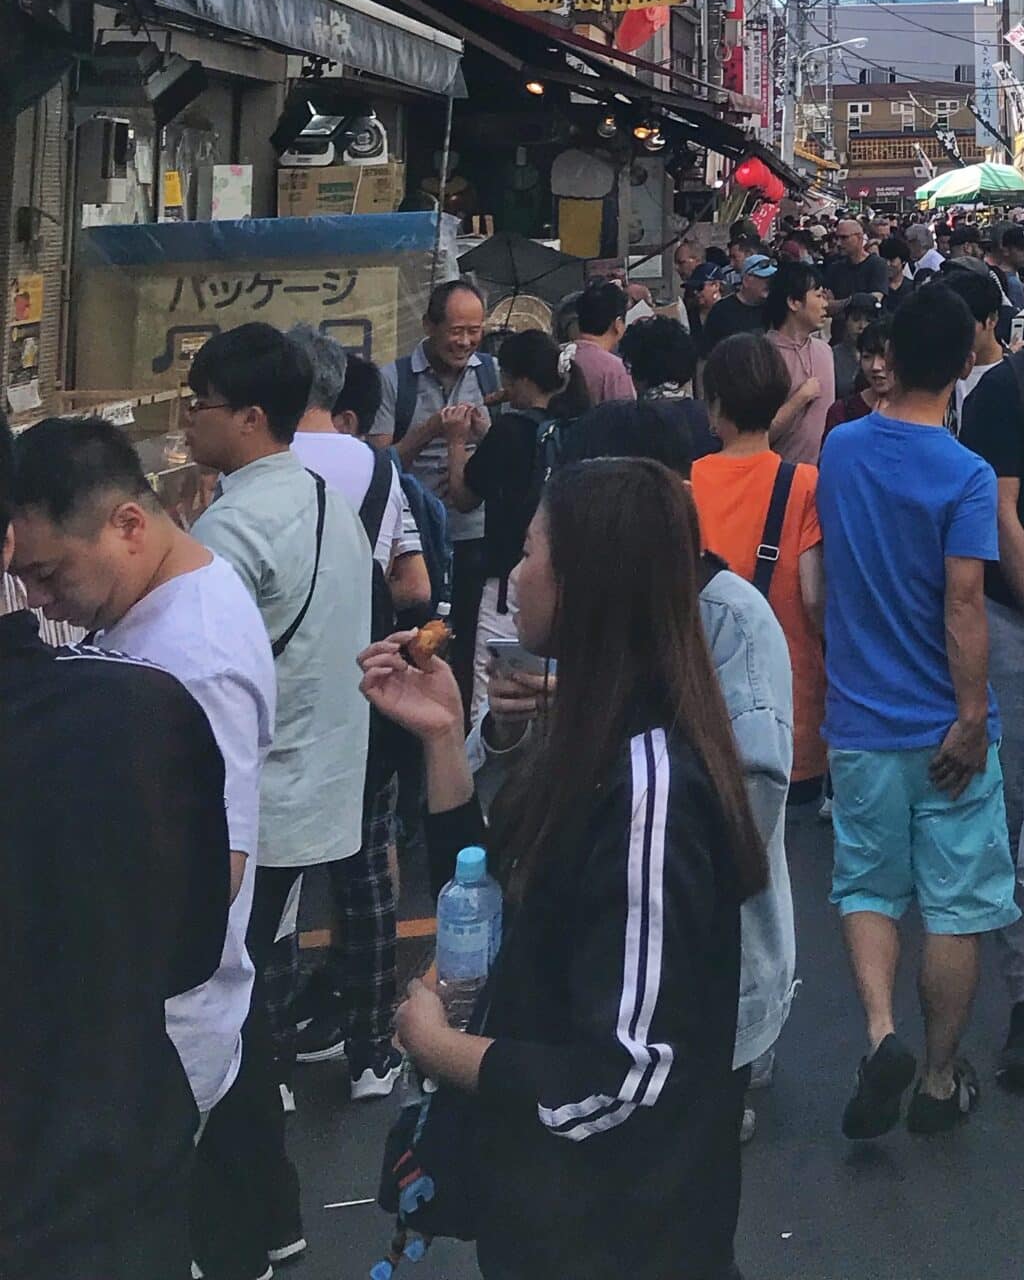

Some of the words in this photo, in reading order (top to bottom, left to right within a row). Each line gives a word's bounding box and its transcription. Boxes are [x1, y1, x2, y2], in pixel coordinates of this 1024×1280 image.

[168, 270, 359, 312] パッケージ
